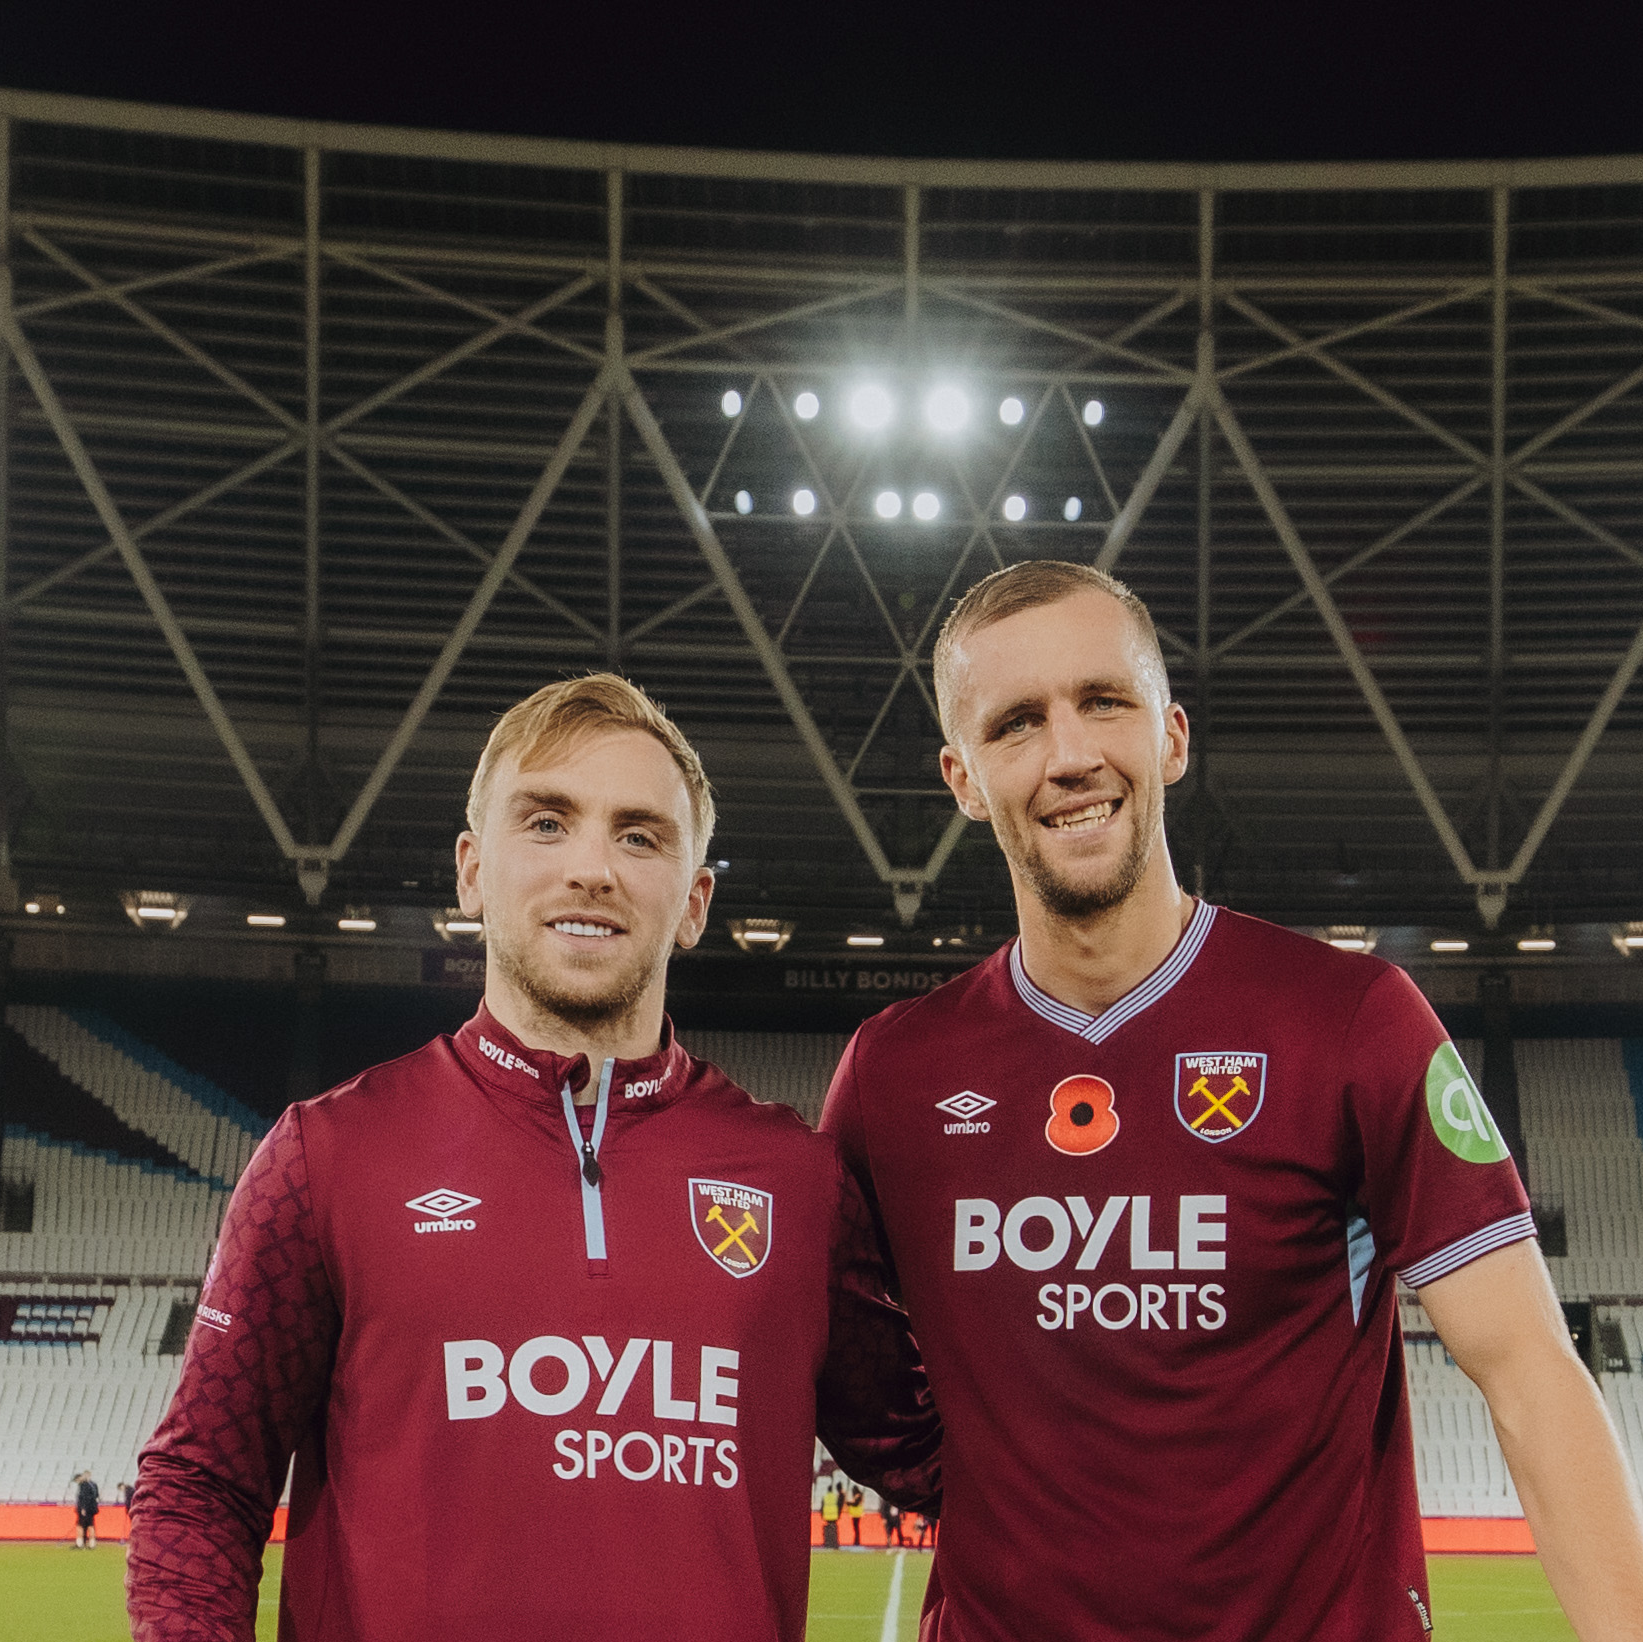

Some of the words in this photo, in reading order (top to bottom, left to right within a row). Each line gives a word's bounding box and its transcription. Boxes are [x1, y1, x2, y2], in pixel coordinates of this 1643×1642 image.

[785, 970, 853, 989] BILLY
[857, 971, 943, 990] BONDS
[478, 1036, 515, 1070] BOYLE
[514, 1057, 539, 1079] SPORTS
[1186, 1056, 1223, 1068] WEST
[1224, 1056, 1257, 1068] HAM
[1200, 1066, 1242, 1075] UNITED
[944, 1120, 991, 1135] umbro
[1200, 1127, 1233, 1136] LONDON
[698, 1184, 732, 1198] WEST
[734, 1190, 763, 1207] HAM
[712, 1196, 751, 1210] UNITED
[414, 1218, 476, 1234] umbro
[954, 1195, 1227, 1272] BOYLE
[1036, 1283, 1227, 1330] SPORTS
[443, 1336, 740, 1427] BOYLE
[552, 1429, 739, 1489] SPORTS
